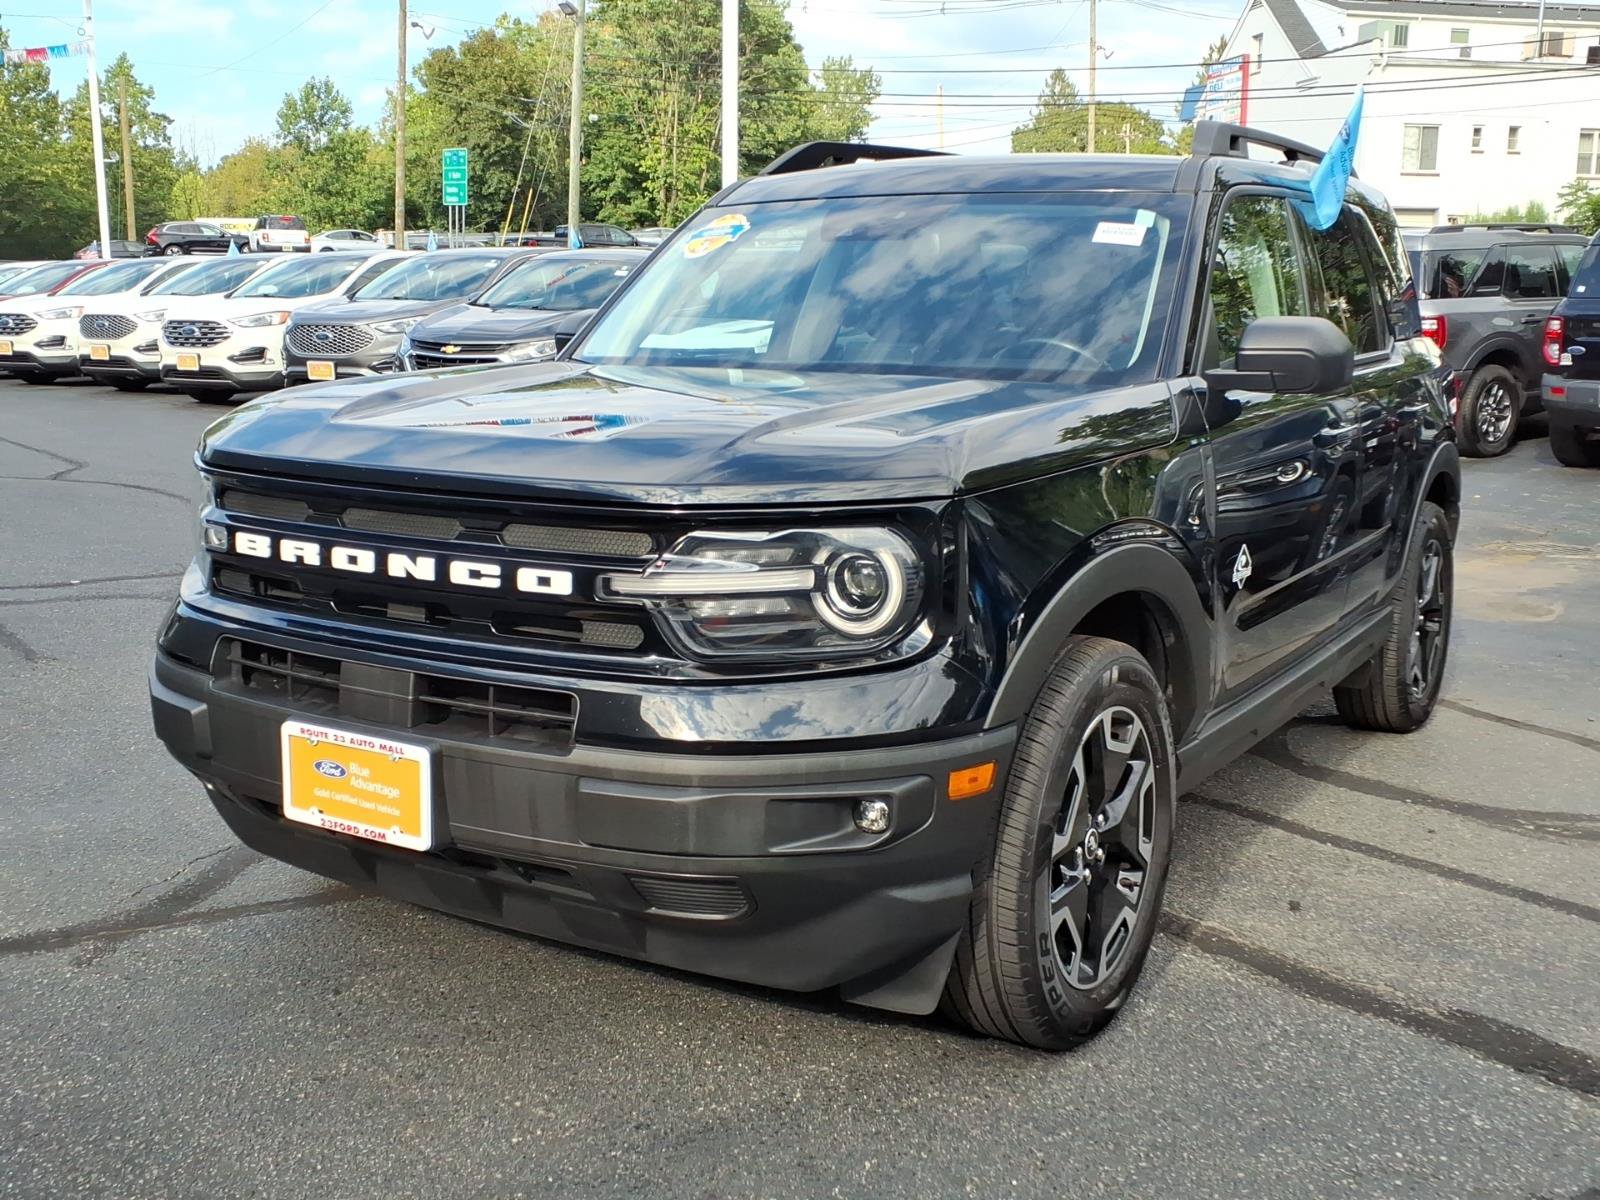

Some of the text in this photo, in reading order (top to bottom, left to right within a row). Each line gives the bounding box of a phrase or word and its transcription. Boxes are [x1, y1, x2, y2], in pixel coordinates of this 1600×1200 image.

[234, 531, 573, 596] BRONCO
[300, 727, 405, 755] ROUTE 23 AUTO MALL
[319, 761, 342, 777] Ford
[349, 762, 370, 777] Blue
[350, 777, 401, 800] Advantage
[320, 818, 387, 841] 23FORD.COM
